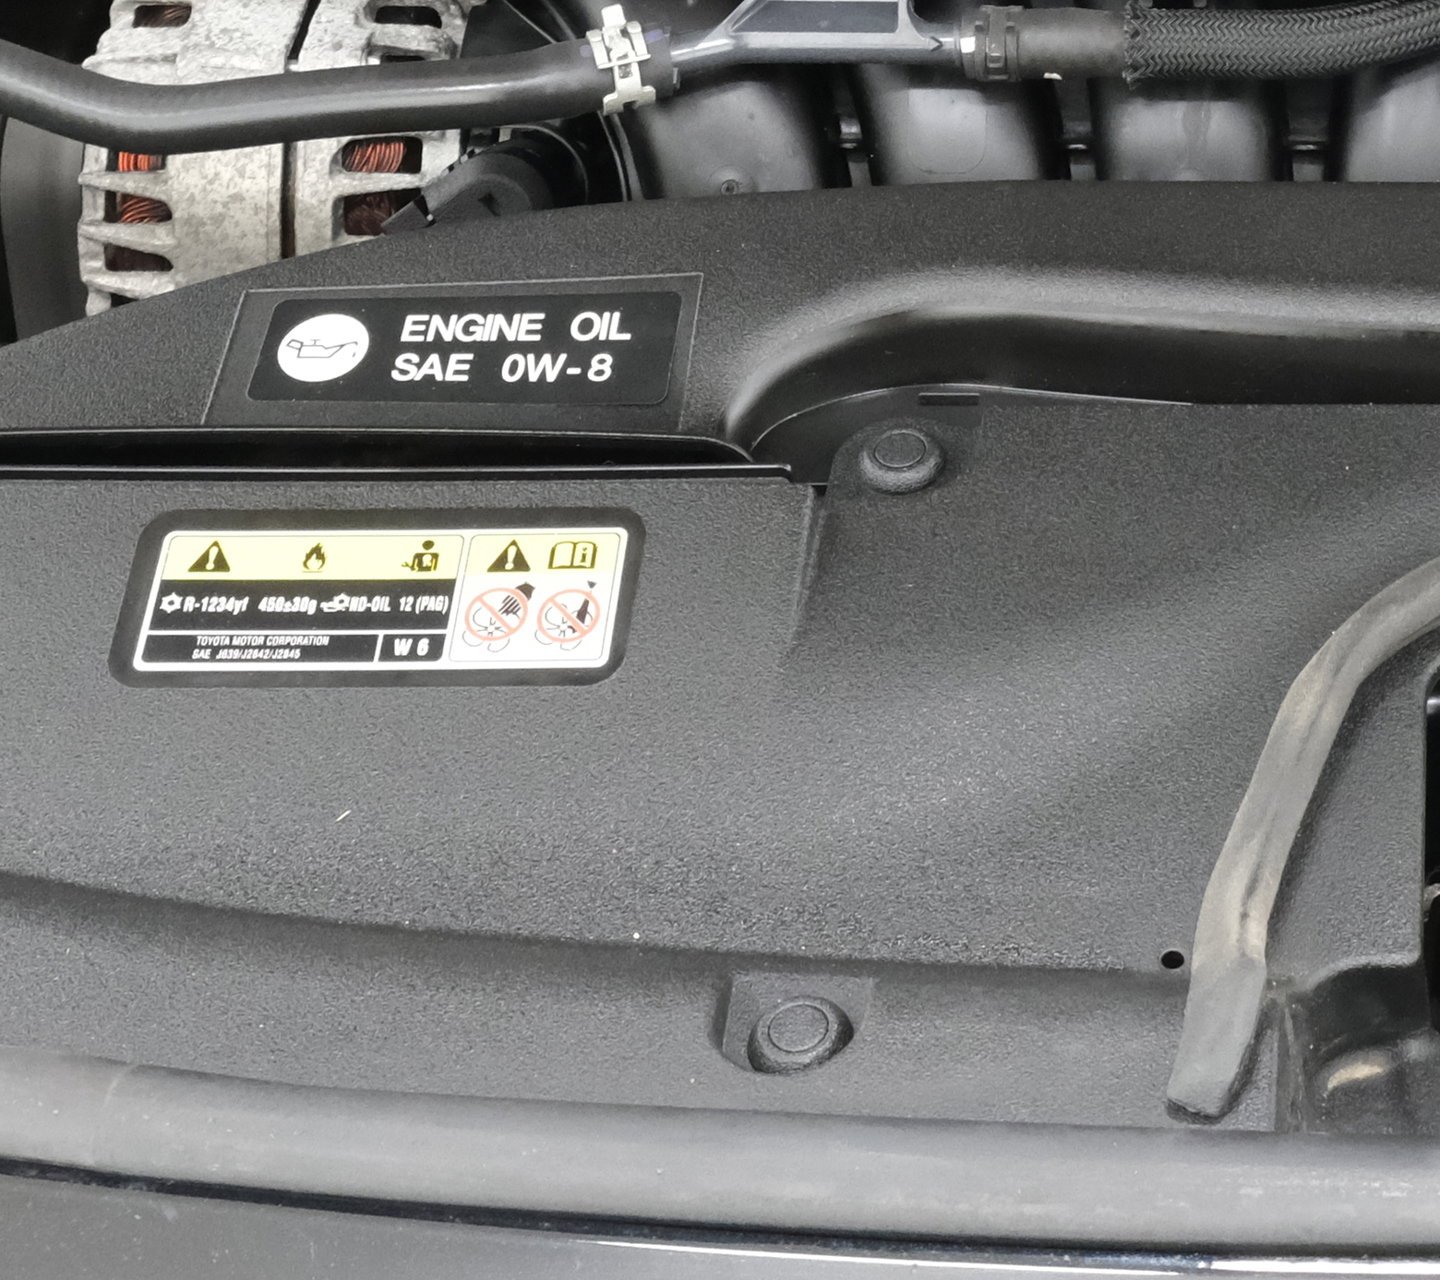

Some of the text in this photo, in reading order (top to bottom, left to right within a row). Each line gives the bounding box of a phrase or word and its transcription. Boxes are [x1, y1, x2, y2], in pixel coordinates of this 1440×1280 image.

[399, 309, 633, 343] ENGINE OIL
[390, 352, 613, 383] SAE 0W-8
[348, 595, 391, 612] ND-OIL
[399, 595, 413, 612] 12
[414, 594, 450, 615] (PAG)
[196, 635, 330, 647] TOYOTA MOTOR CORPORATION
[191, 649, 211, 660] SAE
